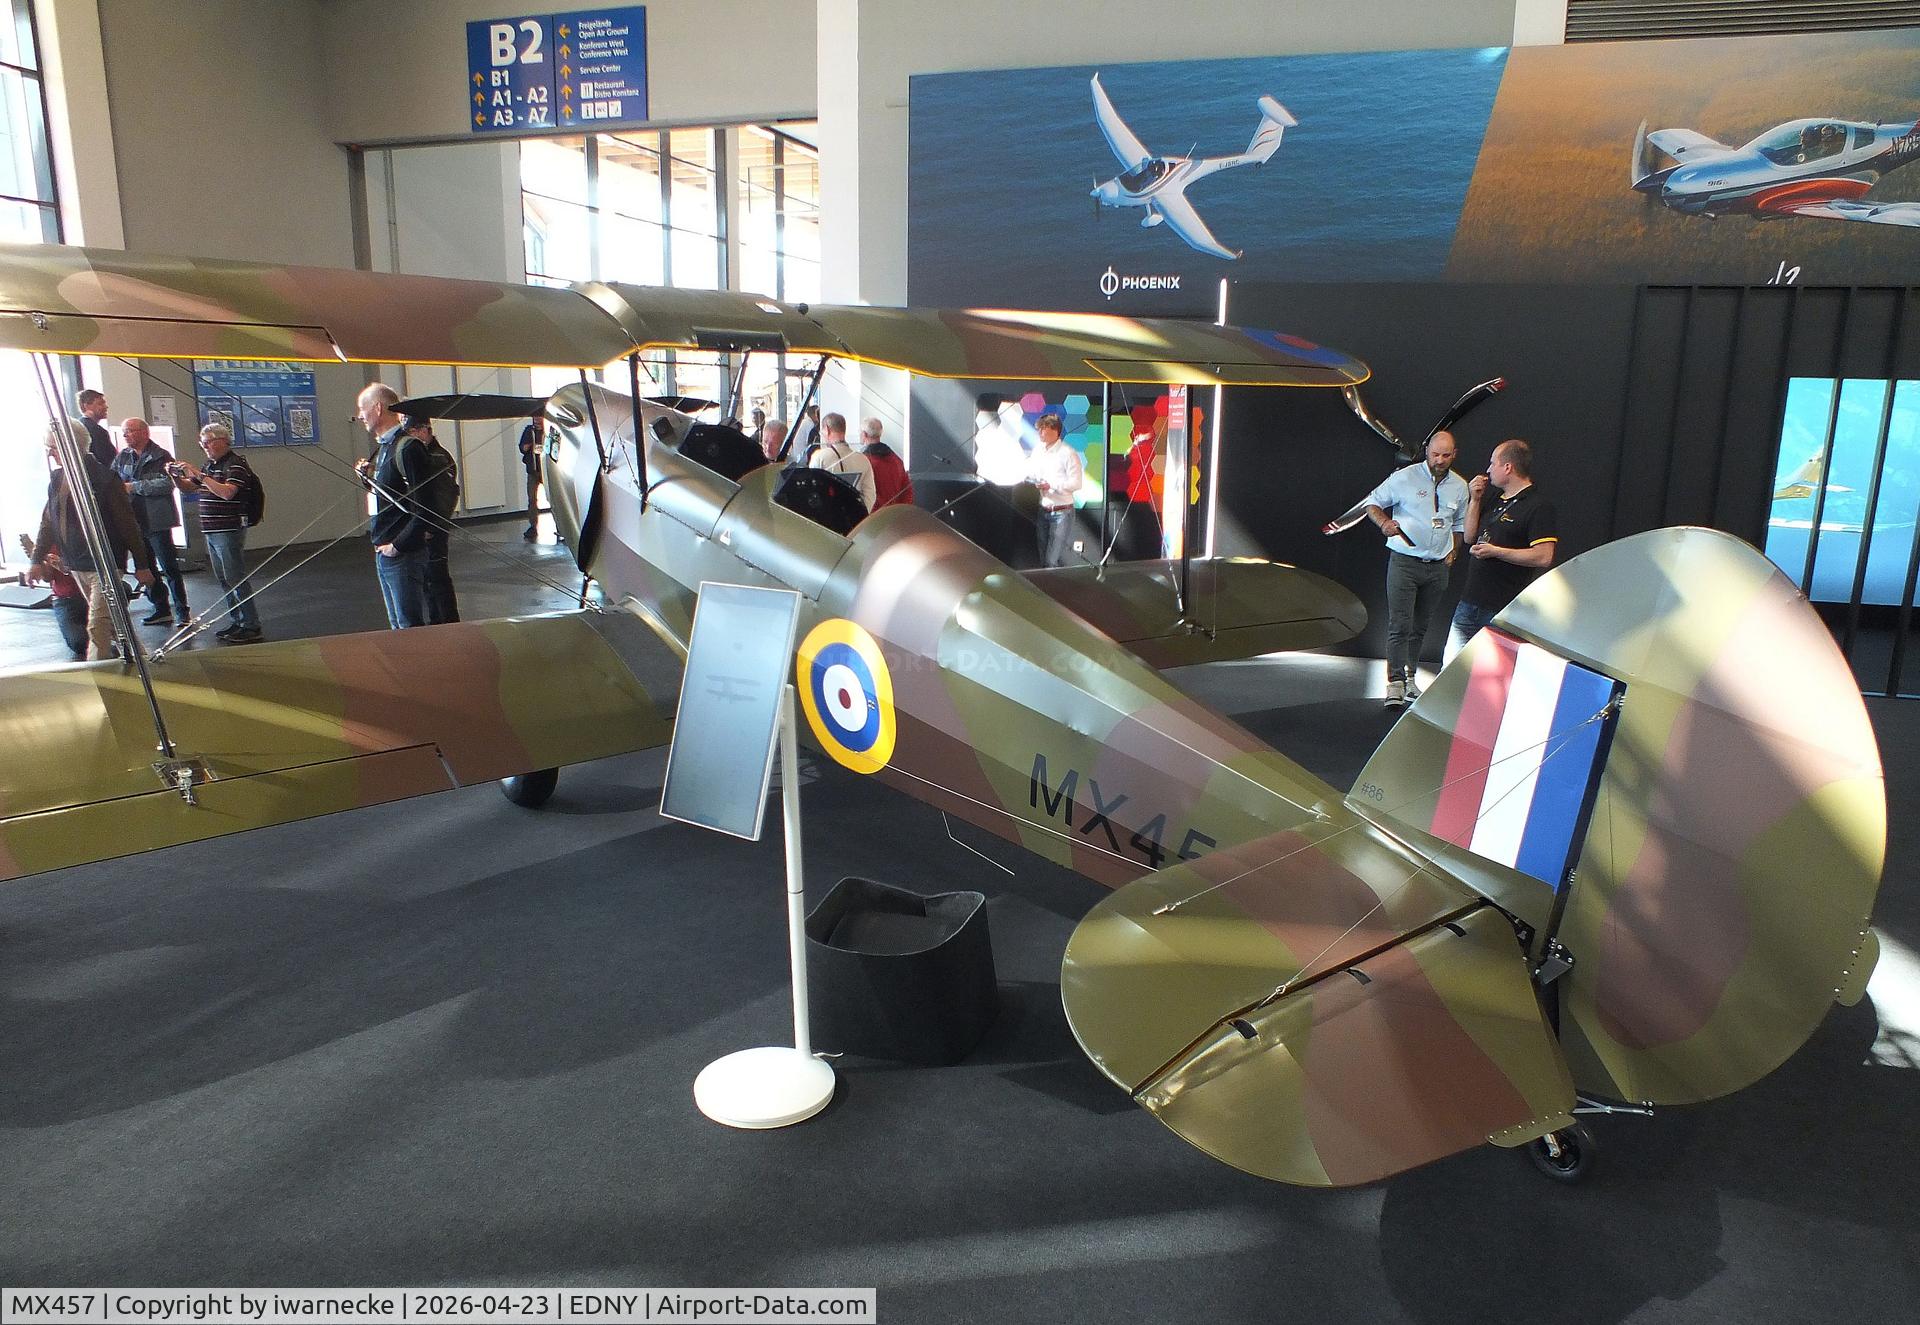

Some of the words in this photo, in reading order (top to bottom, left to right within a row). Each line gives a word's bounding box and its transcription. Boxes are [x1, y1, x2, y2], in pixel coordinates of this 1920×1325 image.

[578, 31, 596, 40] Open
[596, 29, 606, 37] Air
[606, 26, 629, 36] Ground
[490, 20, 544, 67] B2
[608, 39, 625, 48] West
[579, 50, 612, 59] Conference
[612, 48, 629, 56] West
[580, 65, 601, 75] Service
[601, 64, 621, 73] Center
[491, 69, 510, 87] B1
[593, 80, 625, 89] Restaurant
[492, 89, 512, 107] A1
[526, 86, 548, 104] A2
[493, 109, 514, 127] A3
[527, 106, 549, 124] A7
[1121, 275, 1181, 290] PHOENIX
[249, 422, 277, 432] AERO
[1361, 782, 1385, 802] #86
